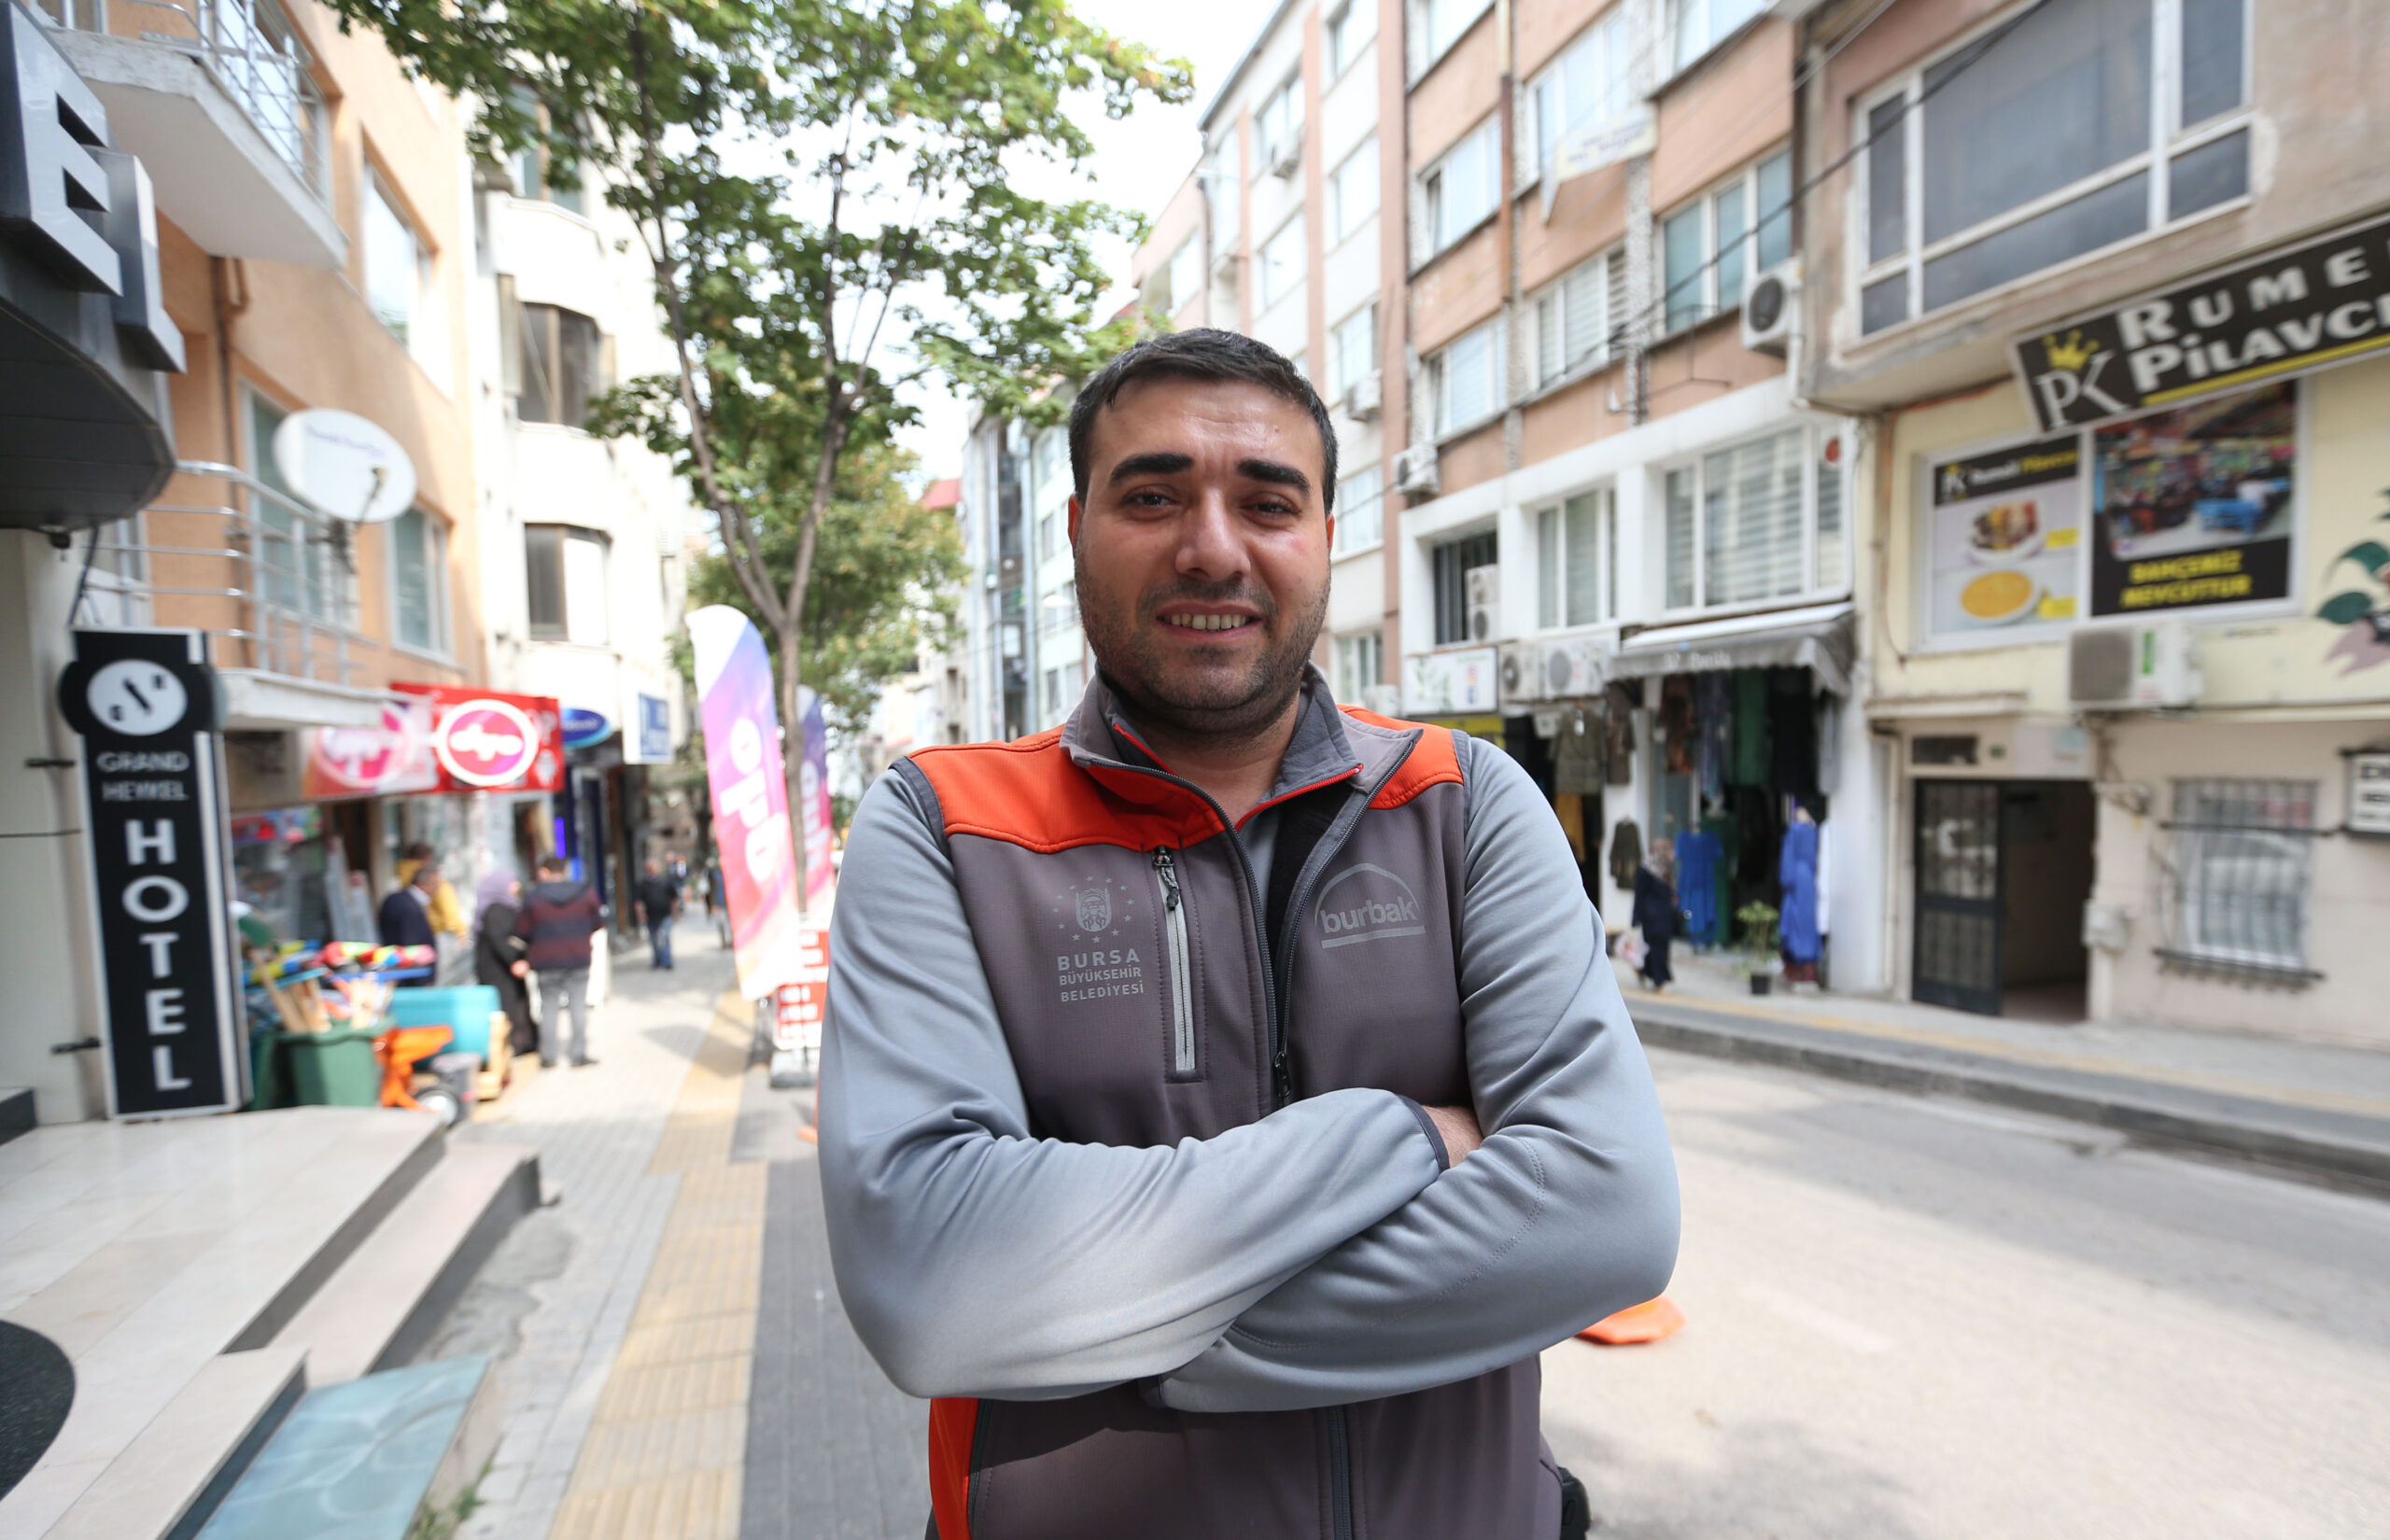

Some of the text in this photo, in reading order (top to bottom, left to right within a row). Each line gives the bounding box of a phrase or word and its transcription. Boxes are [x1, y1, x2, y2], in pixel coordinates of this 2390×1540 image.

[2116, 239, 2390, 349] RUME
[96, 750, 190, 773] GRAND
[1320, 896, 1418, 933] burbak
[122, 818, 192, 1091] HOTEL
[1057, 948, 1140, 972] BURSA
[1061, 980, 1144, 1002] BELEDİYESİ
